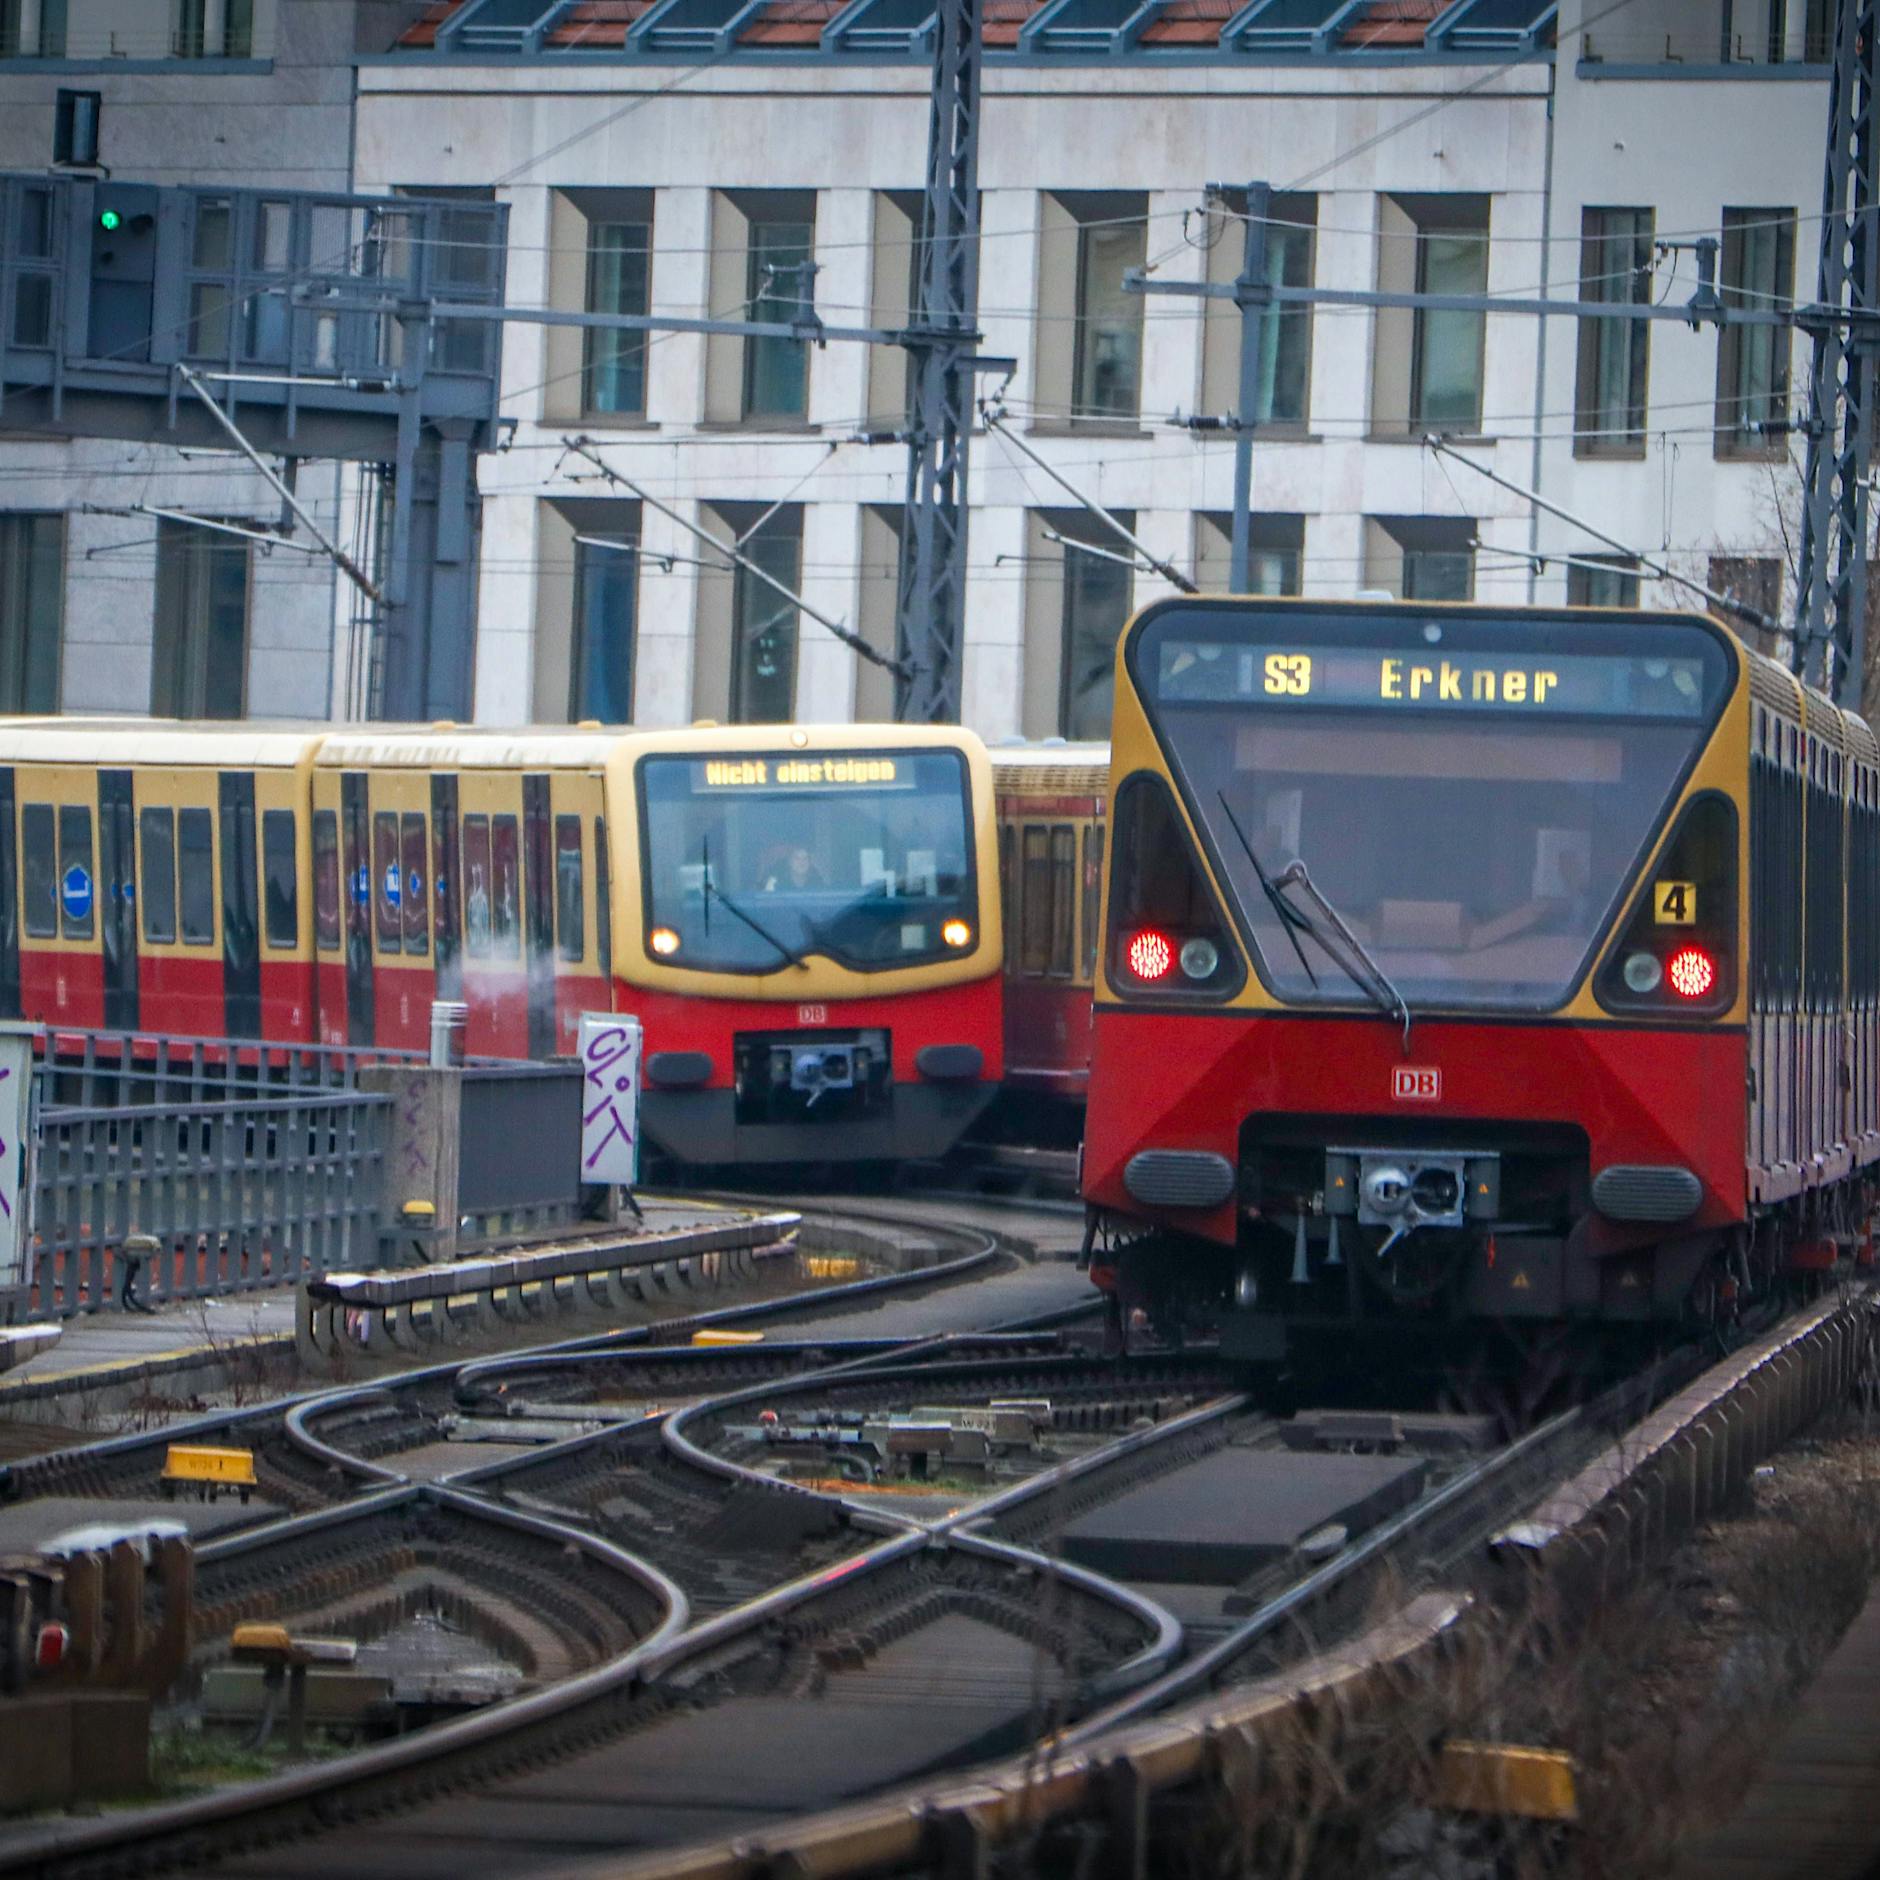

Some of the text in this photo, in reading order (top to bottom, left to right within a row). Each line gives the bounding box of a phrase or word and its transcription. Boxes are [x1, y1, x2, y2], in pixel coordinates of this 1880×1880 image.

[1264, 653, 1558, 704] S3 Erkner
[705, 758, 895, 785] Nicht einsteigen
[1661, 884, 1688, 921] 4
[800, 1006, 824, 1022] DB
[1397, 1070, 1437, 1096] DB
